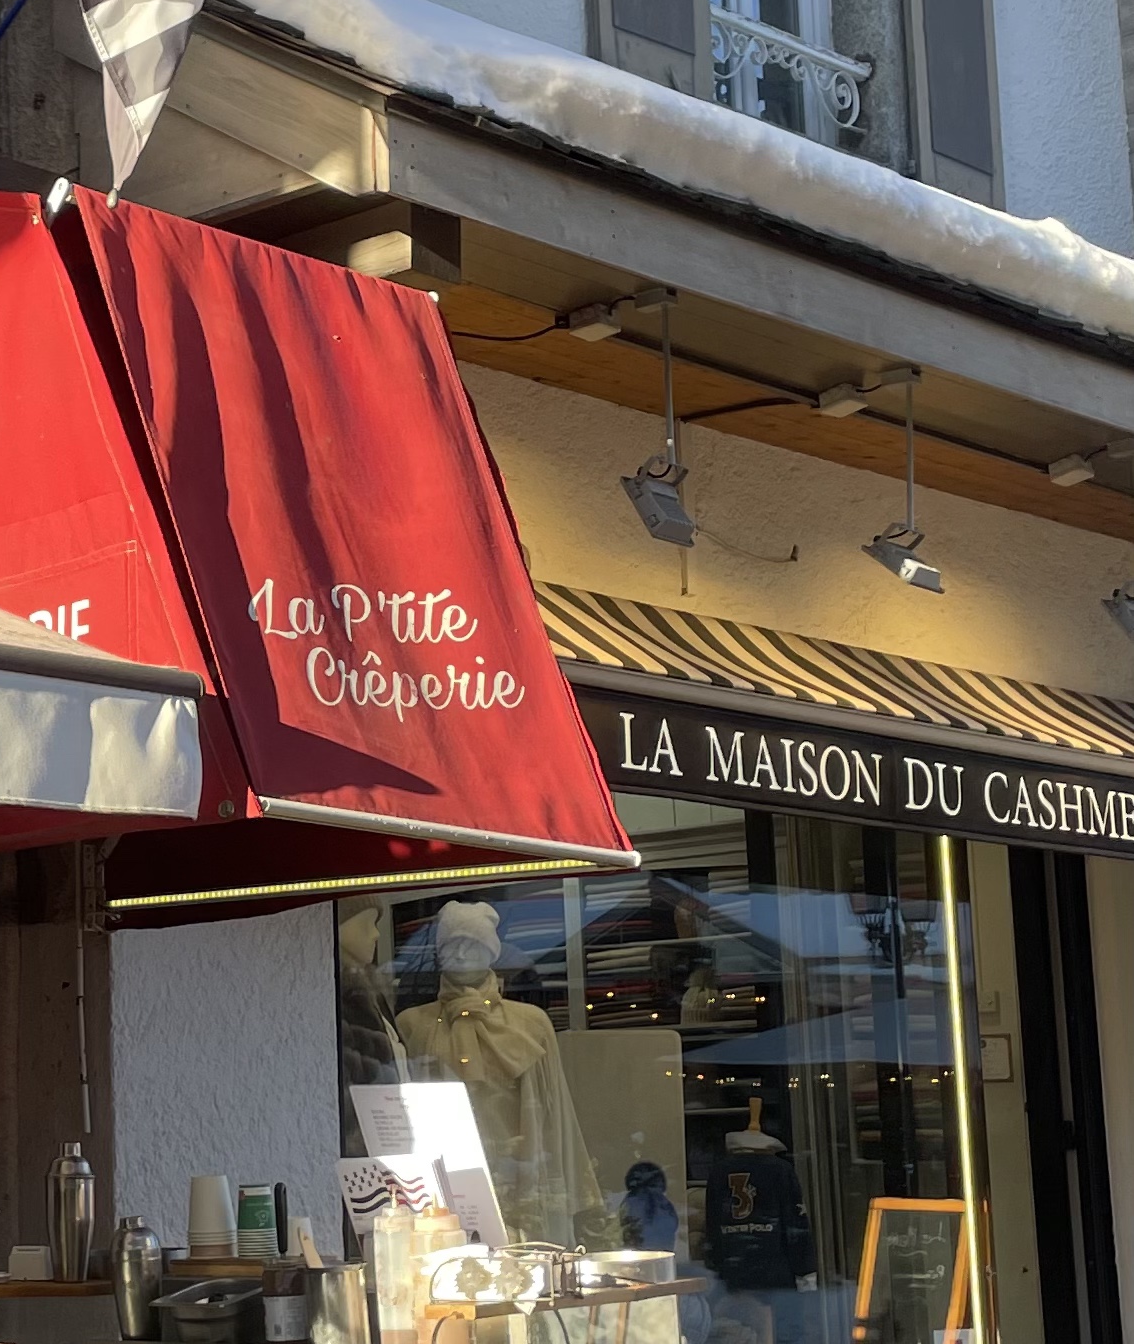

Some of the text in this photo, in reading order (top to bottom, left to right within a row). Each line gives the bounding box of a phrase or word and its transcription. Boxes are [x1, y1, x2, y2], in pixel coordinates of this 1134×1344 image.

[248, 578, 478, 643] La P'tite
[306, 647, 525, 723] Crêperie
[619, 712, 1134, 841] LA MAISON DU CASHME
[728, 1172, 754, 1220] 3
[749, 1223, 773, 1233] POLO
